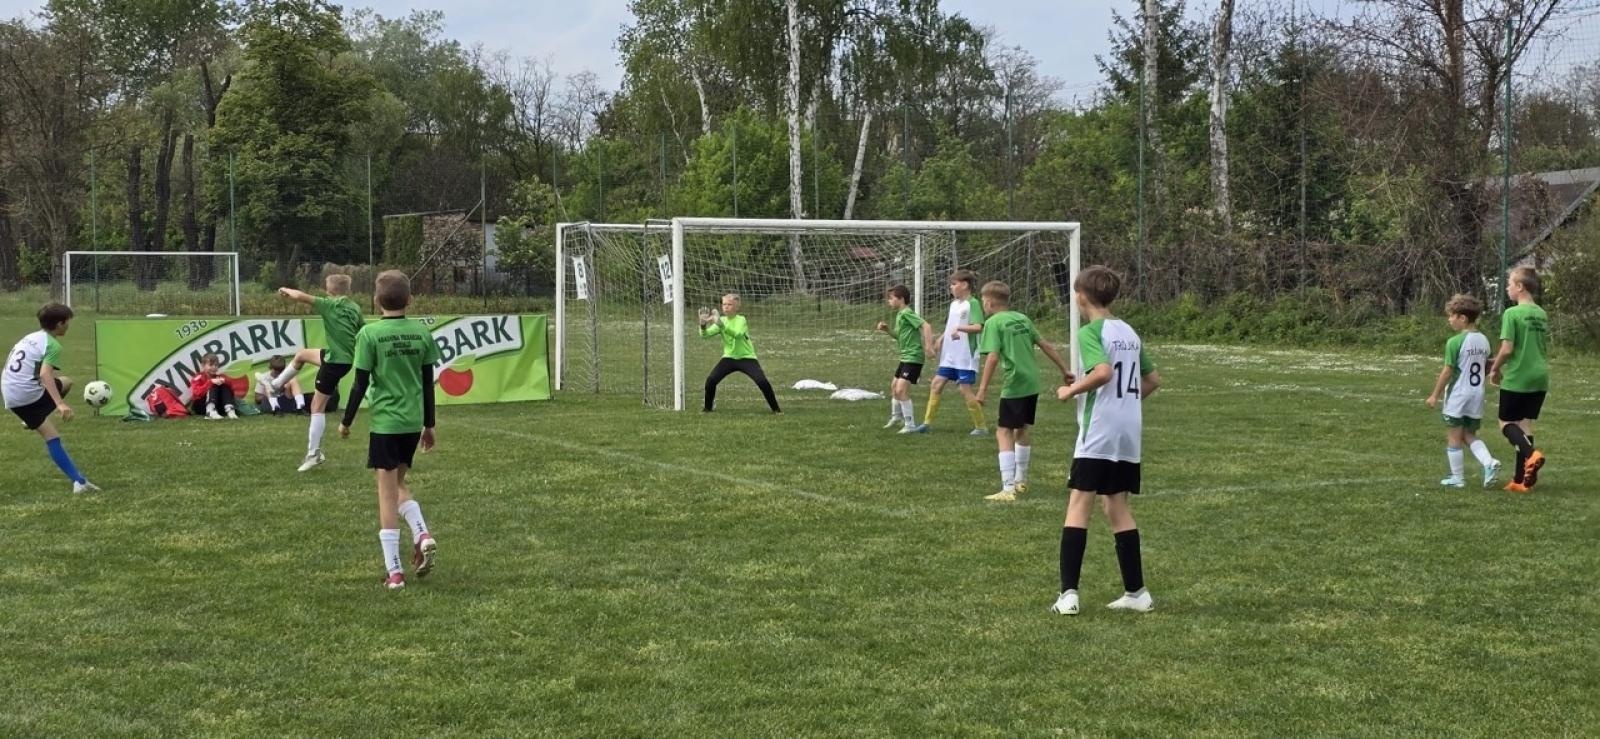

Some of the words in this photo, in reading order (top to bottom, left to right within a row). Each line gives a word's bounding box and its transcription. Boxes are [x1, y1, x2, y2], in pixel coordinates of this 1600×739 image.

[175, 319, 208, 339] 1936
[434, 315, 514, 368] BARK
[1114, 361, 1139, 400] 14
[1469, 362, 1481, 387] 8
